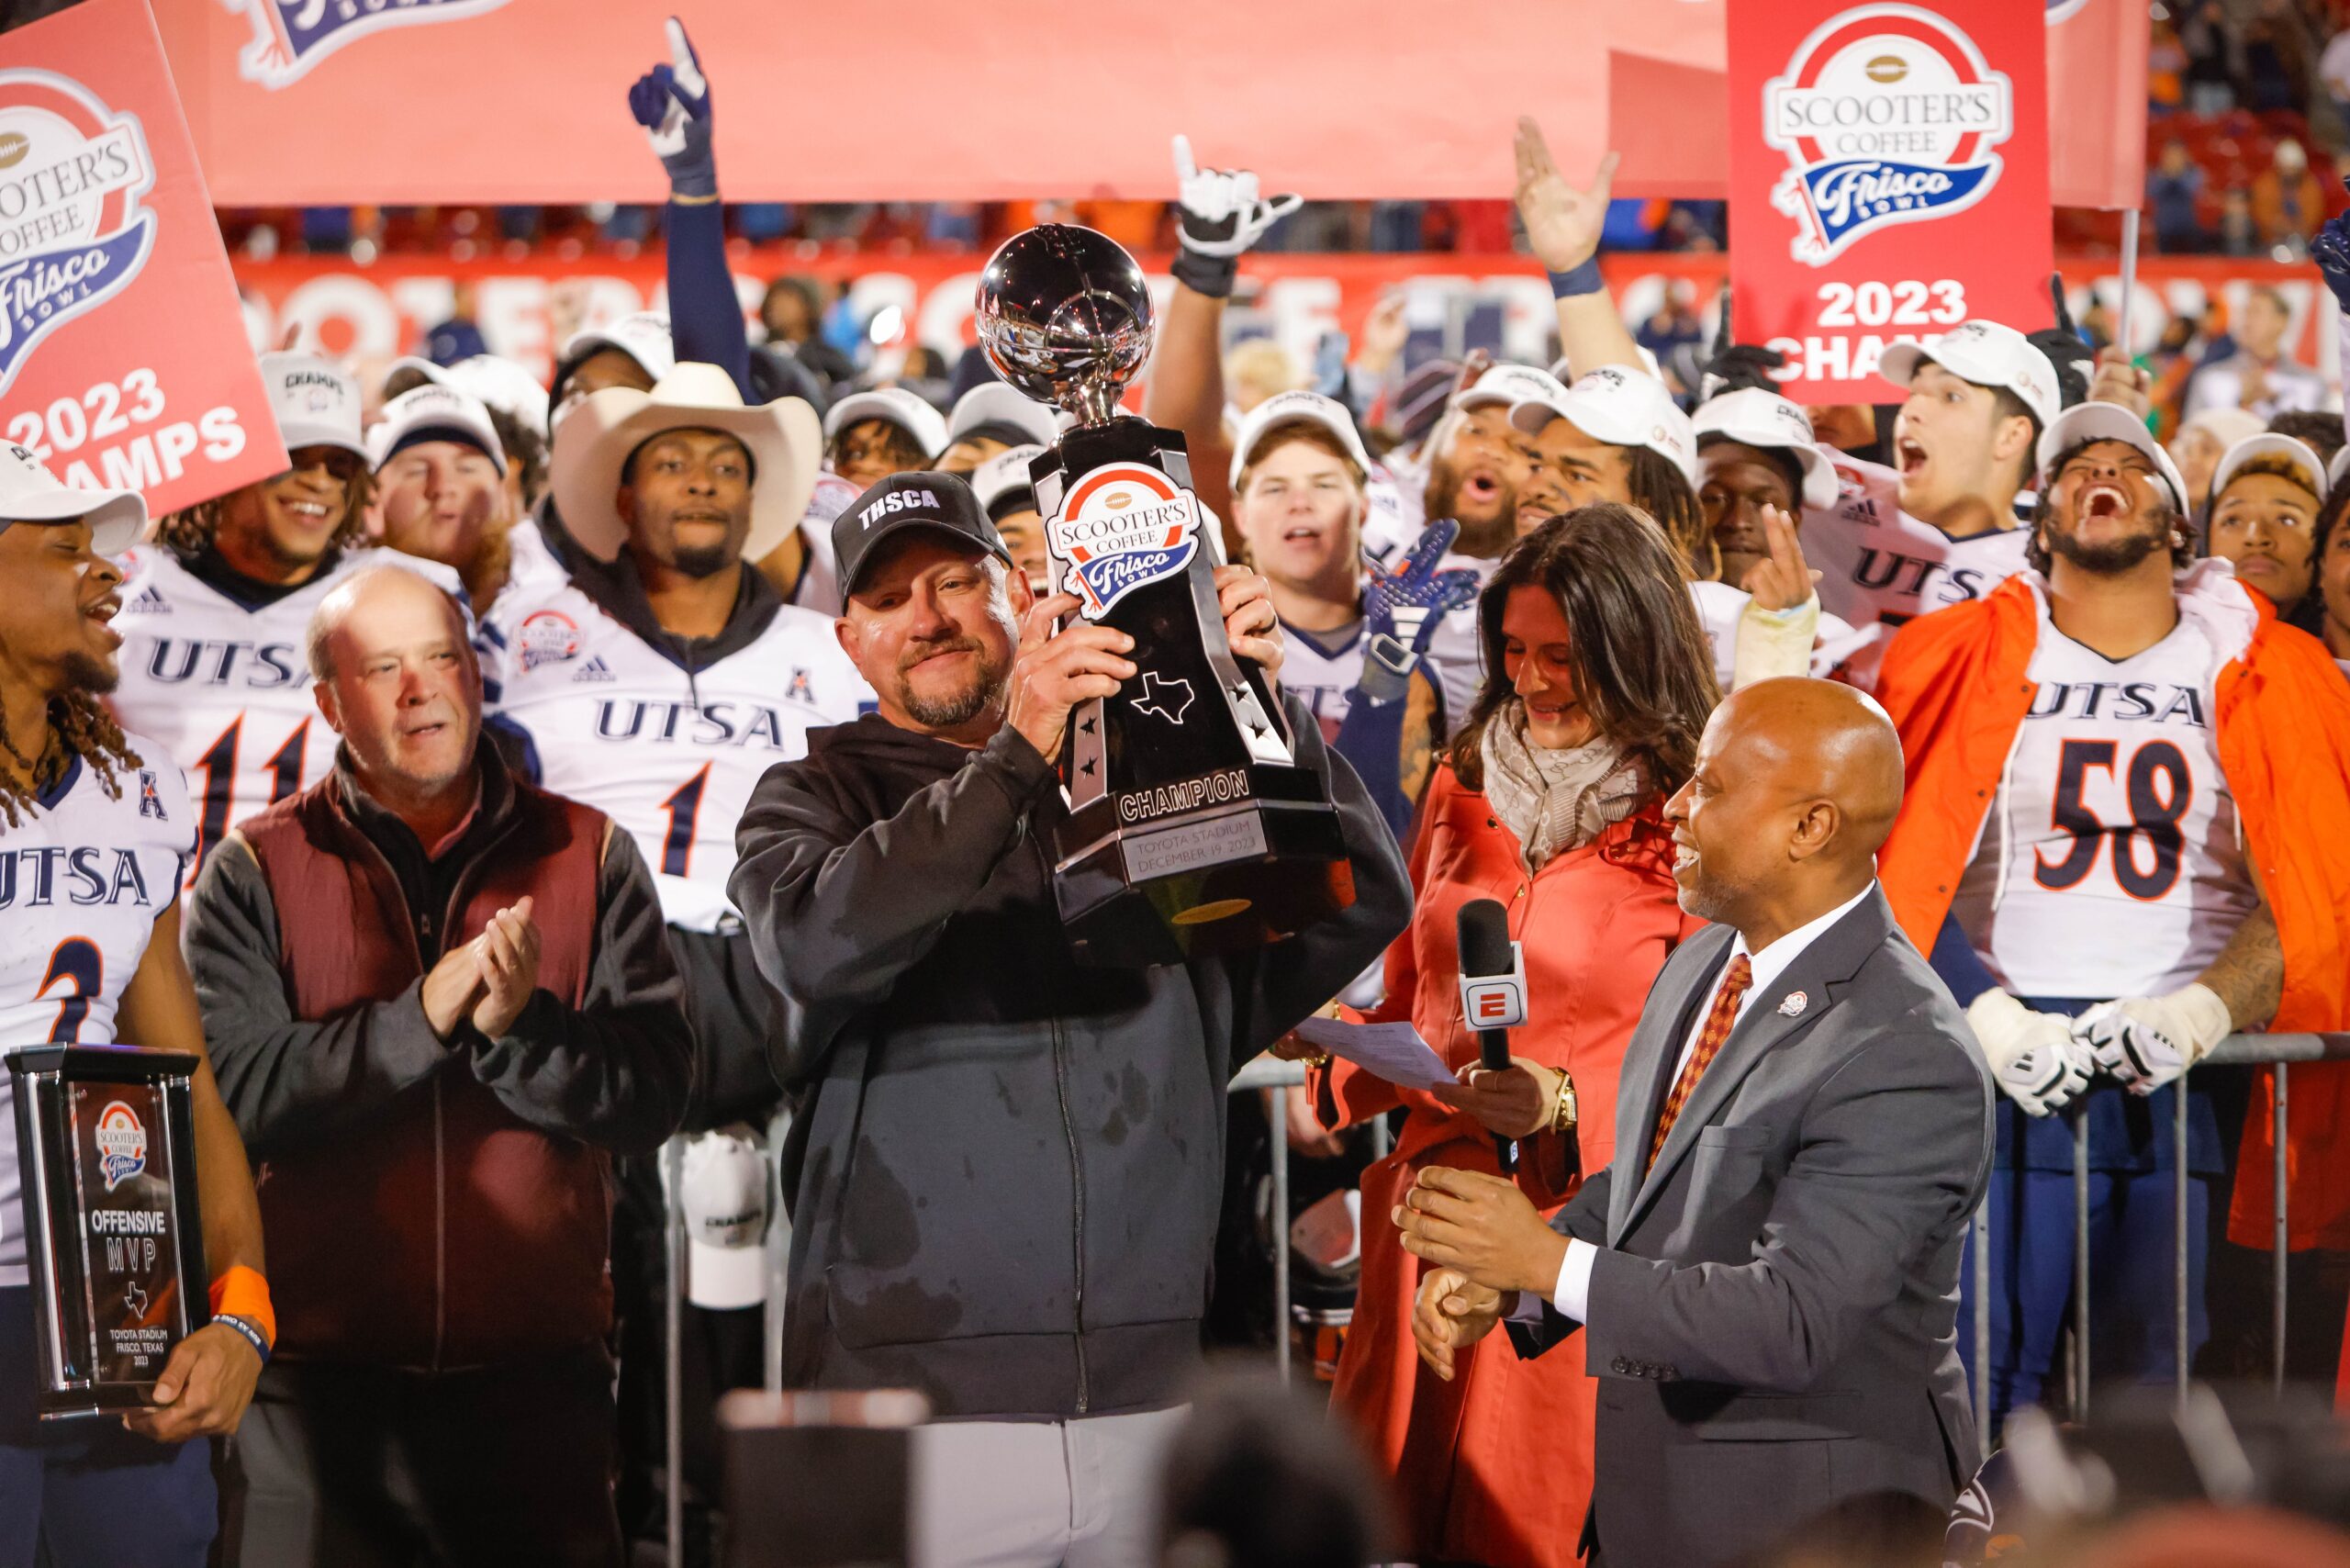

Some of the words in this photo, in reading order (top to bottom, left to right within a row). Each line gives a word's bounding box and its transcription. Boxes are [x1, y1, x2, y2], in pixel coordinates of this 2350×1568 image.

[1785, 93, 1991, 127] SCOOTER'S
[1837, 130, 1938, 153] COFFEE
[1813, 162, 1953, 228] Frisco
[1858, 196, 1929, 219] BOWL
[21, 280, 92, 332] BOWL
[1818, 279, 1967, 327] 2023
[6, 367, 166, 461] 2023
[858, 489, 940, 531] THSCA
[1061, 502, 1186, 545] SCOOTER'S
[1096, 531, 1158, 553] COFFEE
[1089, 553, 1169, 595] Frisco
[1118, 568, 1158, 588] BOWL
[1852, 545, 2007, 604] UTS
[148, 635, 310, 689] UTS
[593, 699, 785, 751] UTSA
[1120, 769, 1249, 821] CHAMPION
[658, 759, 713, 879] 1
[2033, 737, 2193, 901] 58
[1136, 834, 1189, 854] TOYOTA
[1192, 821, 1250, 843] STADIUM
[1138, 849, 1205, 872] DECEMBER
[1229, 836, 1256, 853] 2023
[100, 1131, 142, 1144] SCOOTER'S
[111, 1145, 132, 1154] COFFEE
[109, 1157, 136, 1177] Frisco
[92, 1209, 165, 1233] OFFENSIVE
[106, 1238, 156, 1271] MVP
[109, 1329, 137, 1339] TOYOTA
[139, 1329, 167, 1339] STADIUM
[116, 1343, 141, 1353] FRISCO,
[142, 1343, 163, 1352] TEXAS
[134, 1355, 149, 1366] 2023
